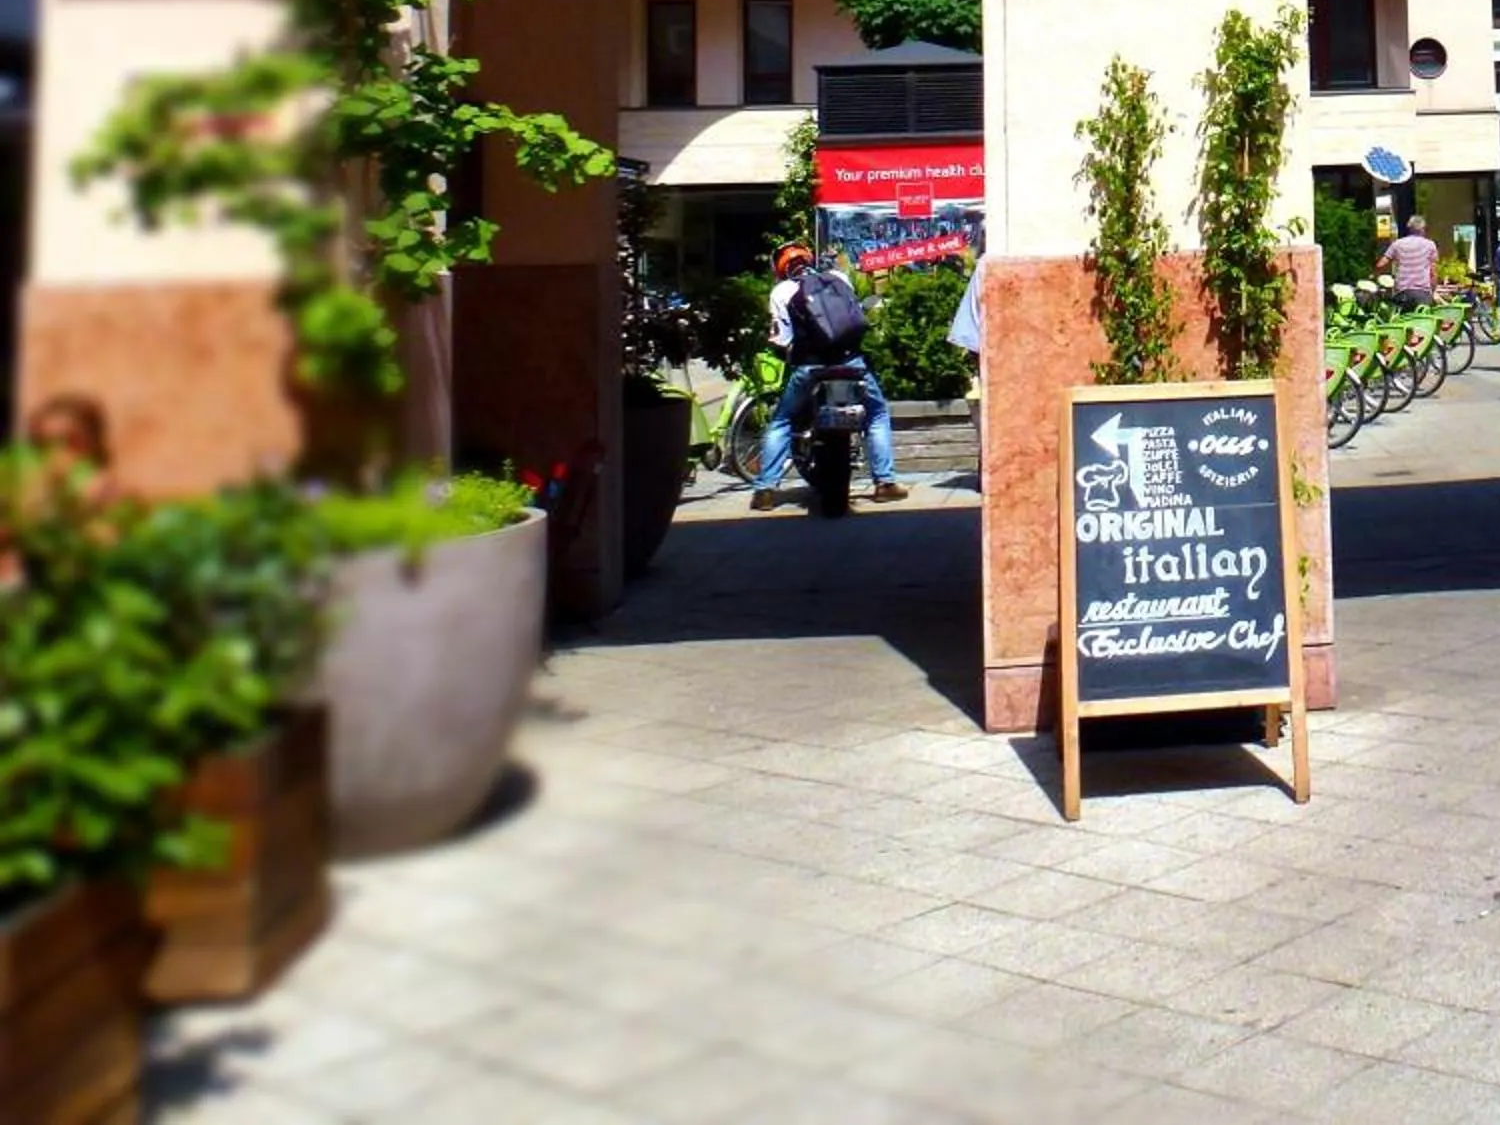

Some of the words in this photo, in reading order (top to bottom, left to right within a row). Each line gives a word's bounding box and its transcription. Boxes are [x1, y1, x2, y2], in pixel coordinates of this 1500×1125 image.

[835, 167, 864, 182] Your
[867, 166, 923, 183] premium
[926, 163, 965, 178] health
[1202, 407, 1258, 427] ITALIAN
[1075, 506, 1225, 544] ORIGINAL
[1122, 542, 1268, 601] italian
[1081, 586, 1230, 623] restaurant
[1077, 625, 1229, 661] Exclusive
[1228, 612, 1285, 662] Chef
